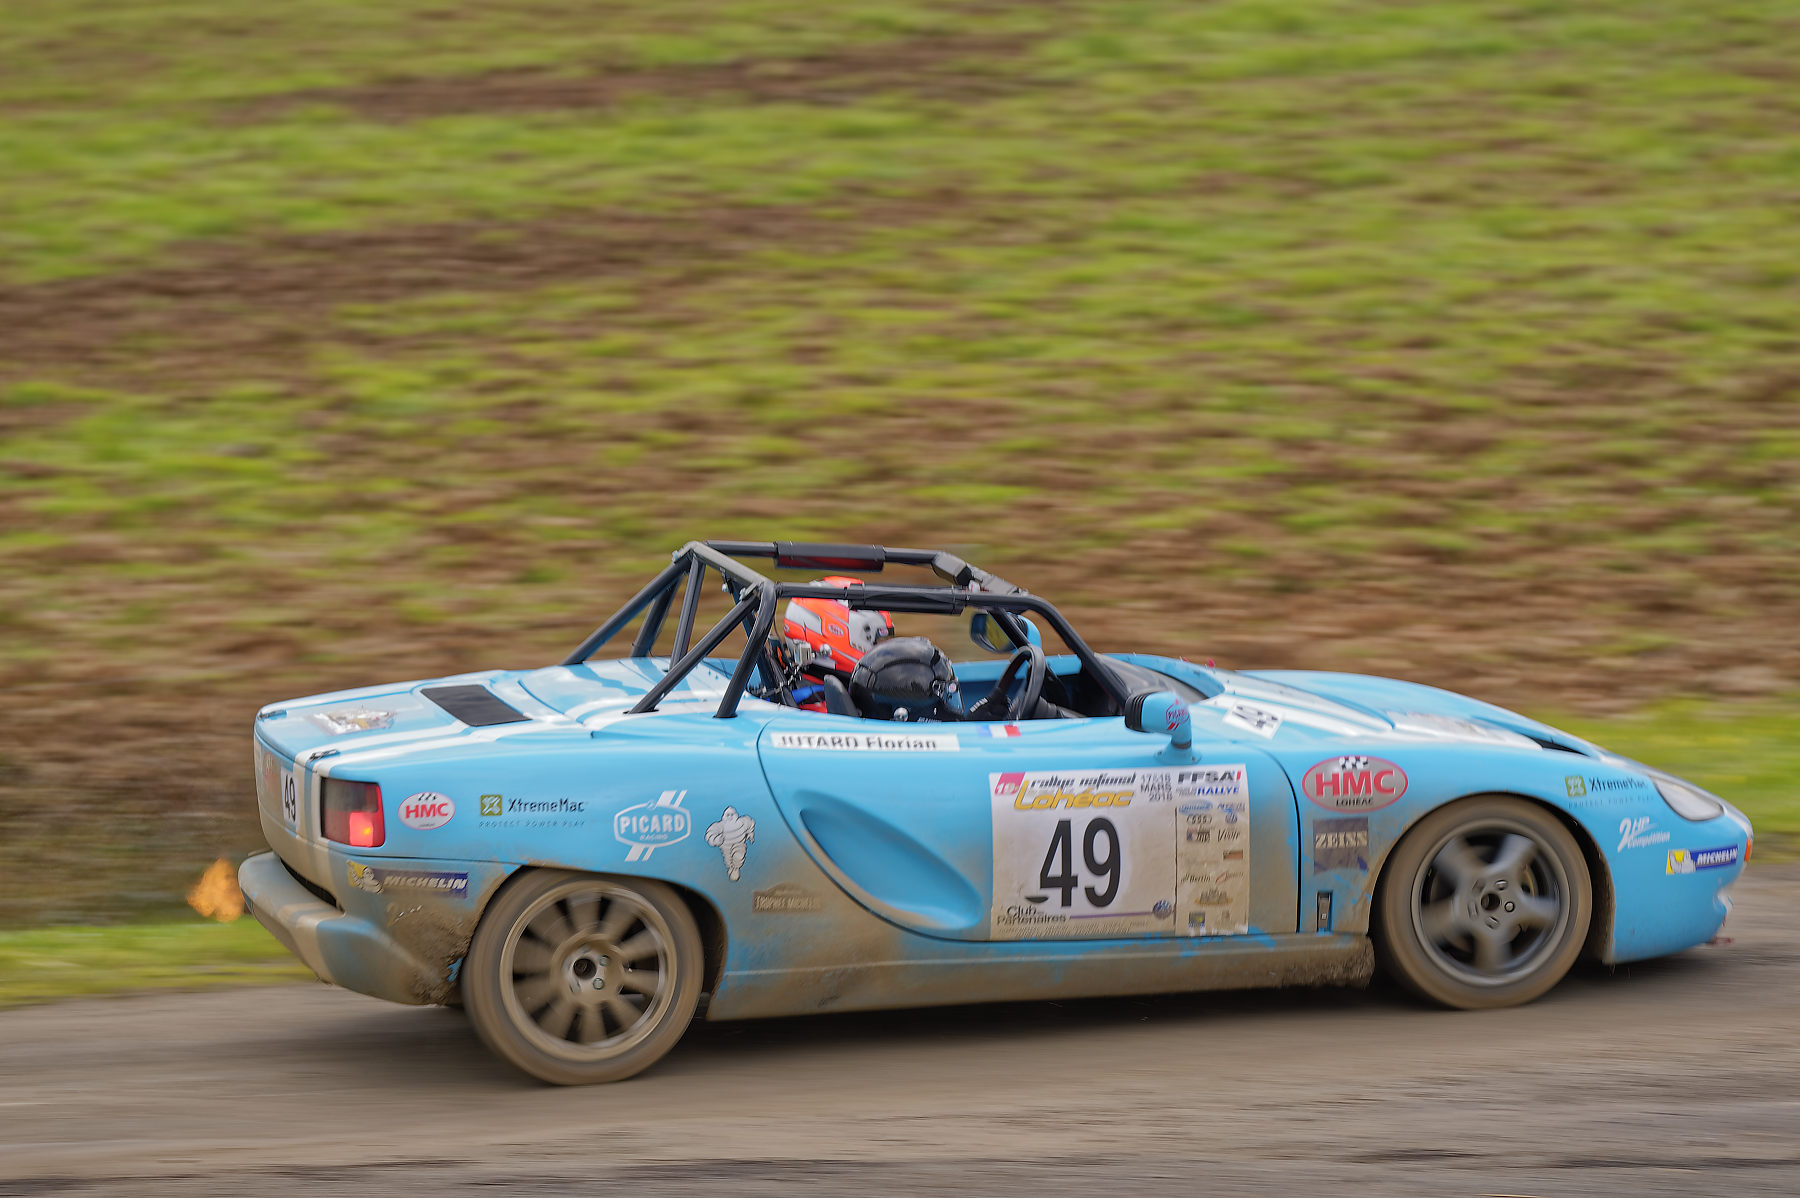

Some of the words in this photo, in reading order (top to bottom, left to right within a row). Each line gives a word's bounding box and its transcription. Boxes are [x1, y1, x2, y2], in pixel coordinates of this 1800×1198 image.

[866, 736, 936, 749] Florian
[1080, 772, 1136, 789] national
[1178, 771, 1234, 784] FFSA
[1315, 769, 1394, 797] HMC
[285, 774, 295, 822] 49
[1014, 780, 1134, 810] Lohéac
[1197, 787, 1240, 796] RALLYE
[405, 803, 449, 819] HMC
[508, 799, 585, 813] XtremeMac
[620, 814, 685, 834] PICARD
[1315, 831, 1367, 849] ZEISS
[1040, 817, 1121, 908] 49
[1696, 848, 1738, 866] MICHELIN
[383, 875, 468, 890] MICHELIN
[1007, 905, 1036, 916] Club
